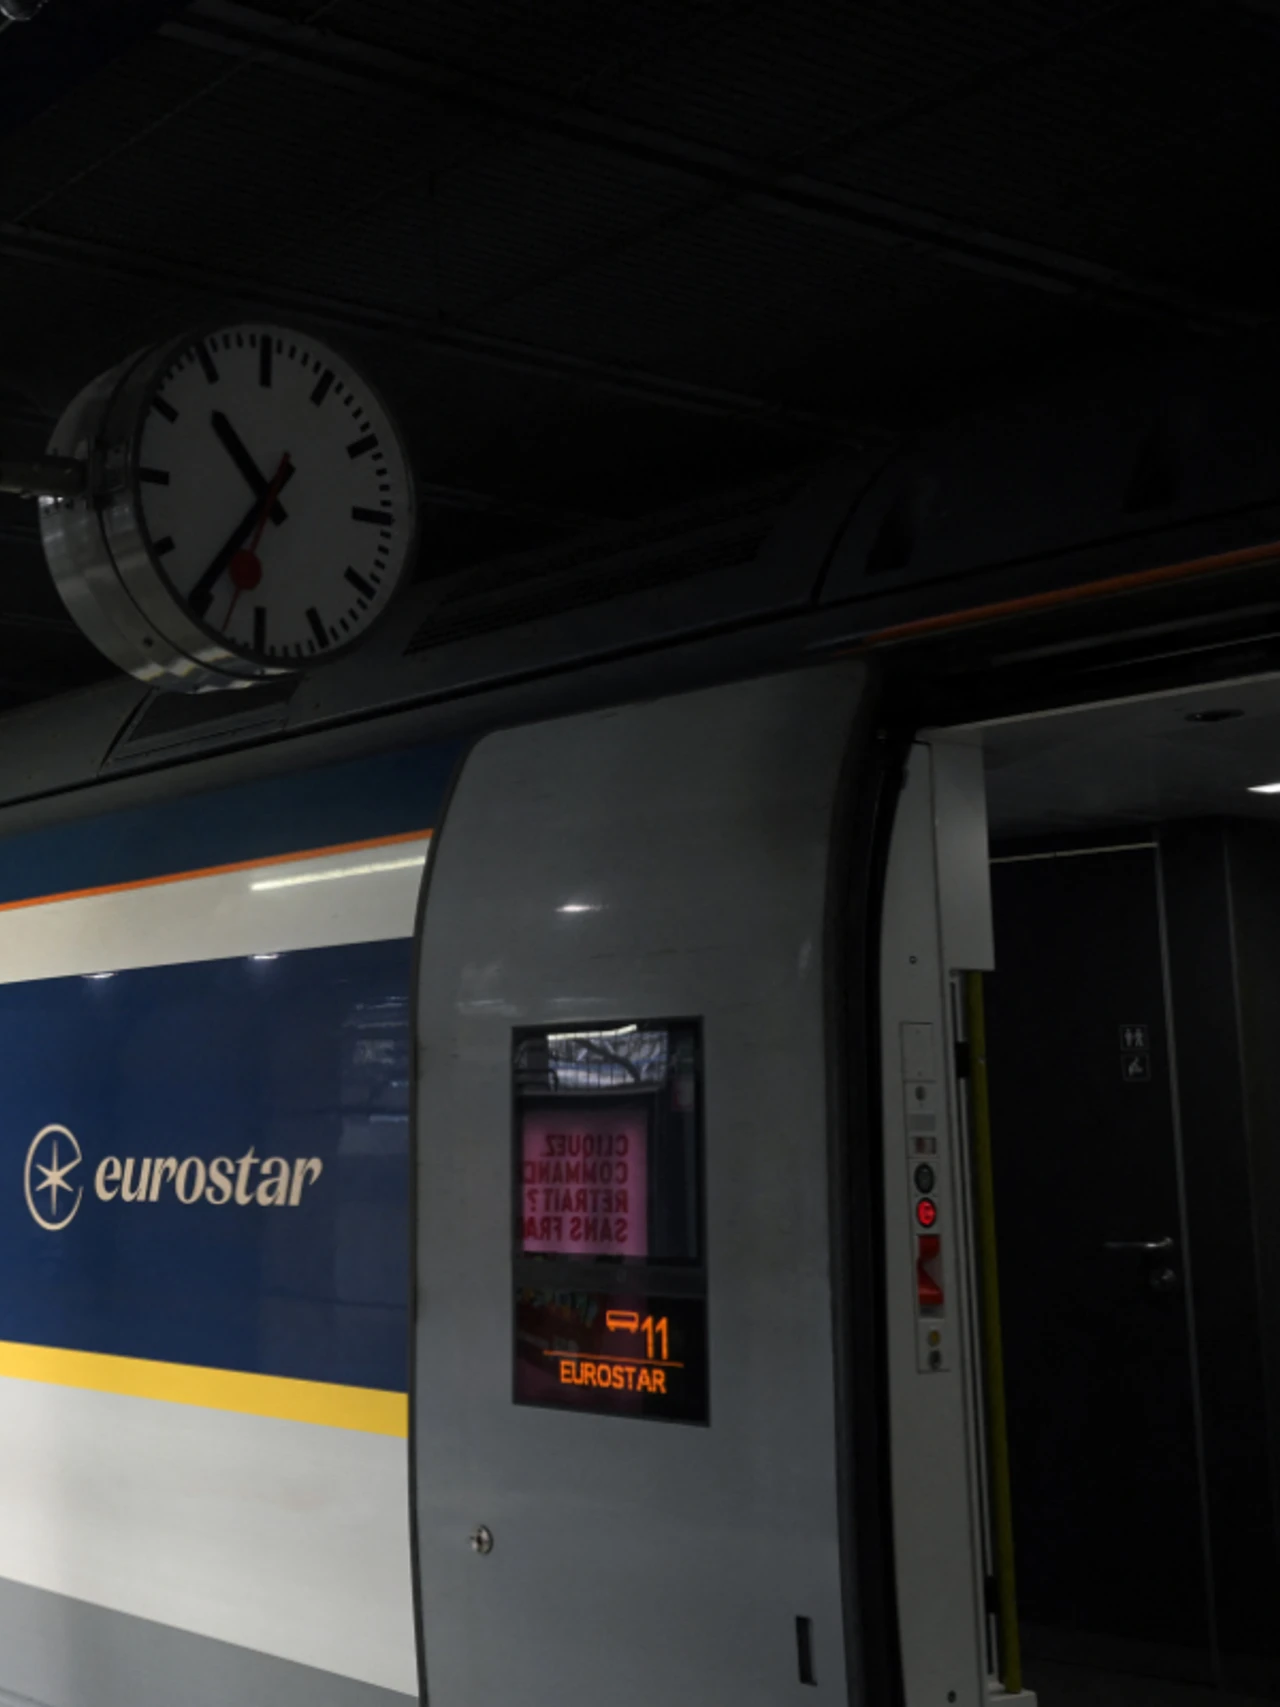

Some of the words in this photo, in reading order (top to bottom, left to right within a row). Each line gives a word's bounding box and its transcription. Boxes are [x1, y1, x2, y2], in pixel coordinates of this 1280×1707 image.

[93, 1145, 324, 1207] eurostar
[641, 1315, 669, 1361] 11
[560, 1360, 667, 1394] EUROSTAR
